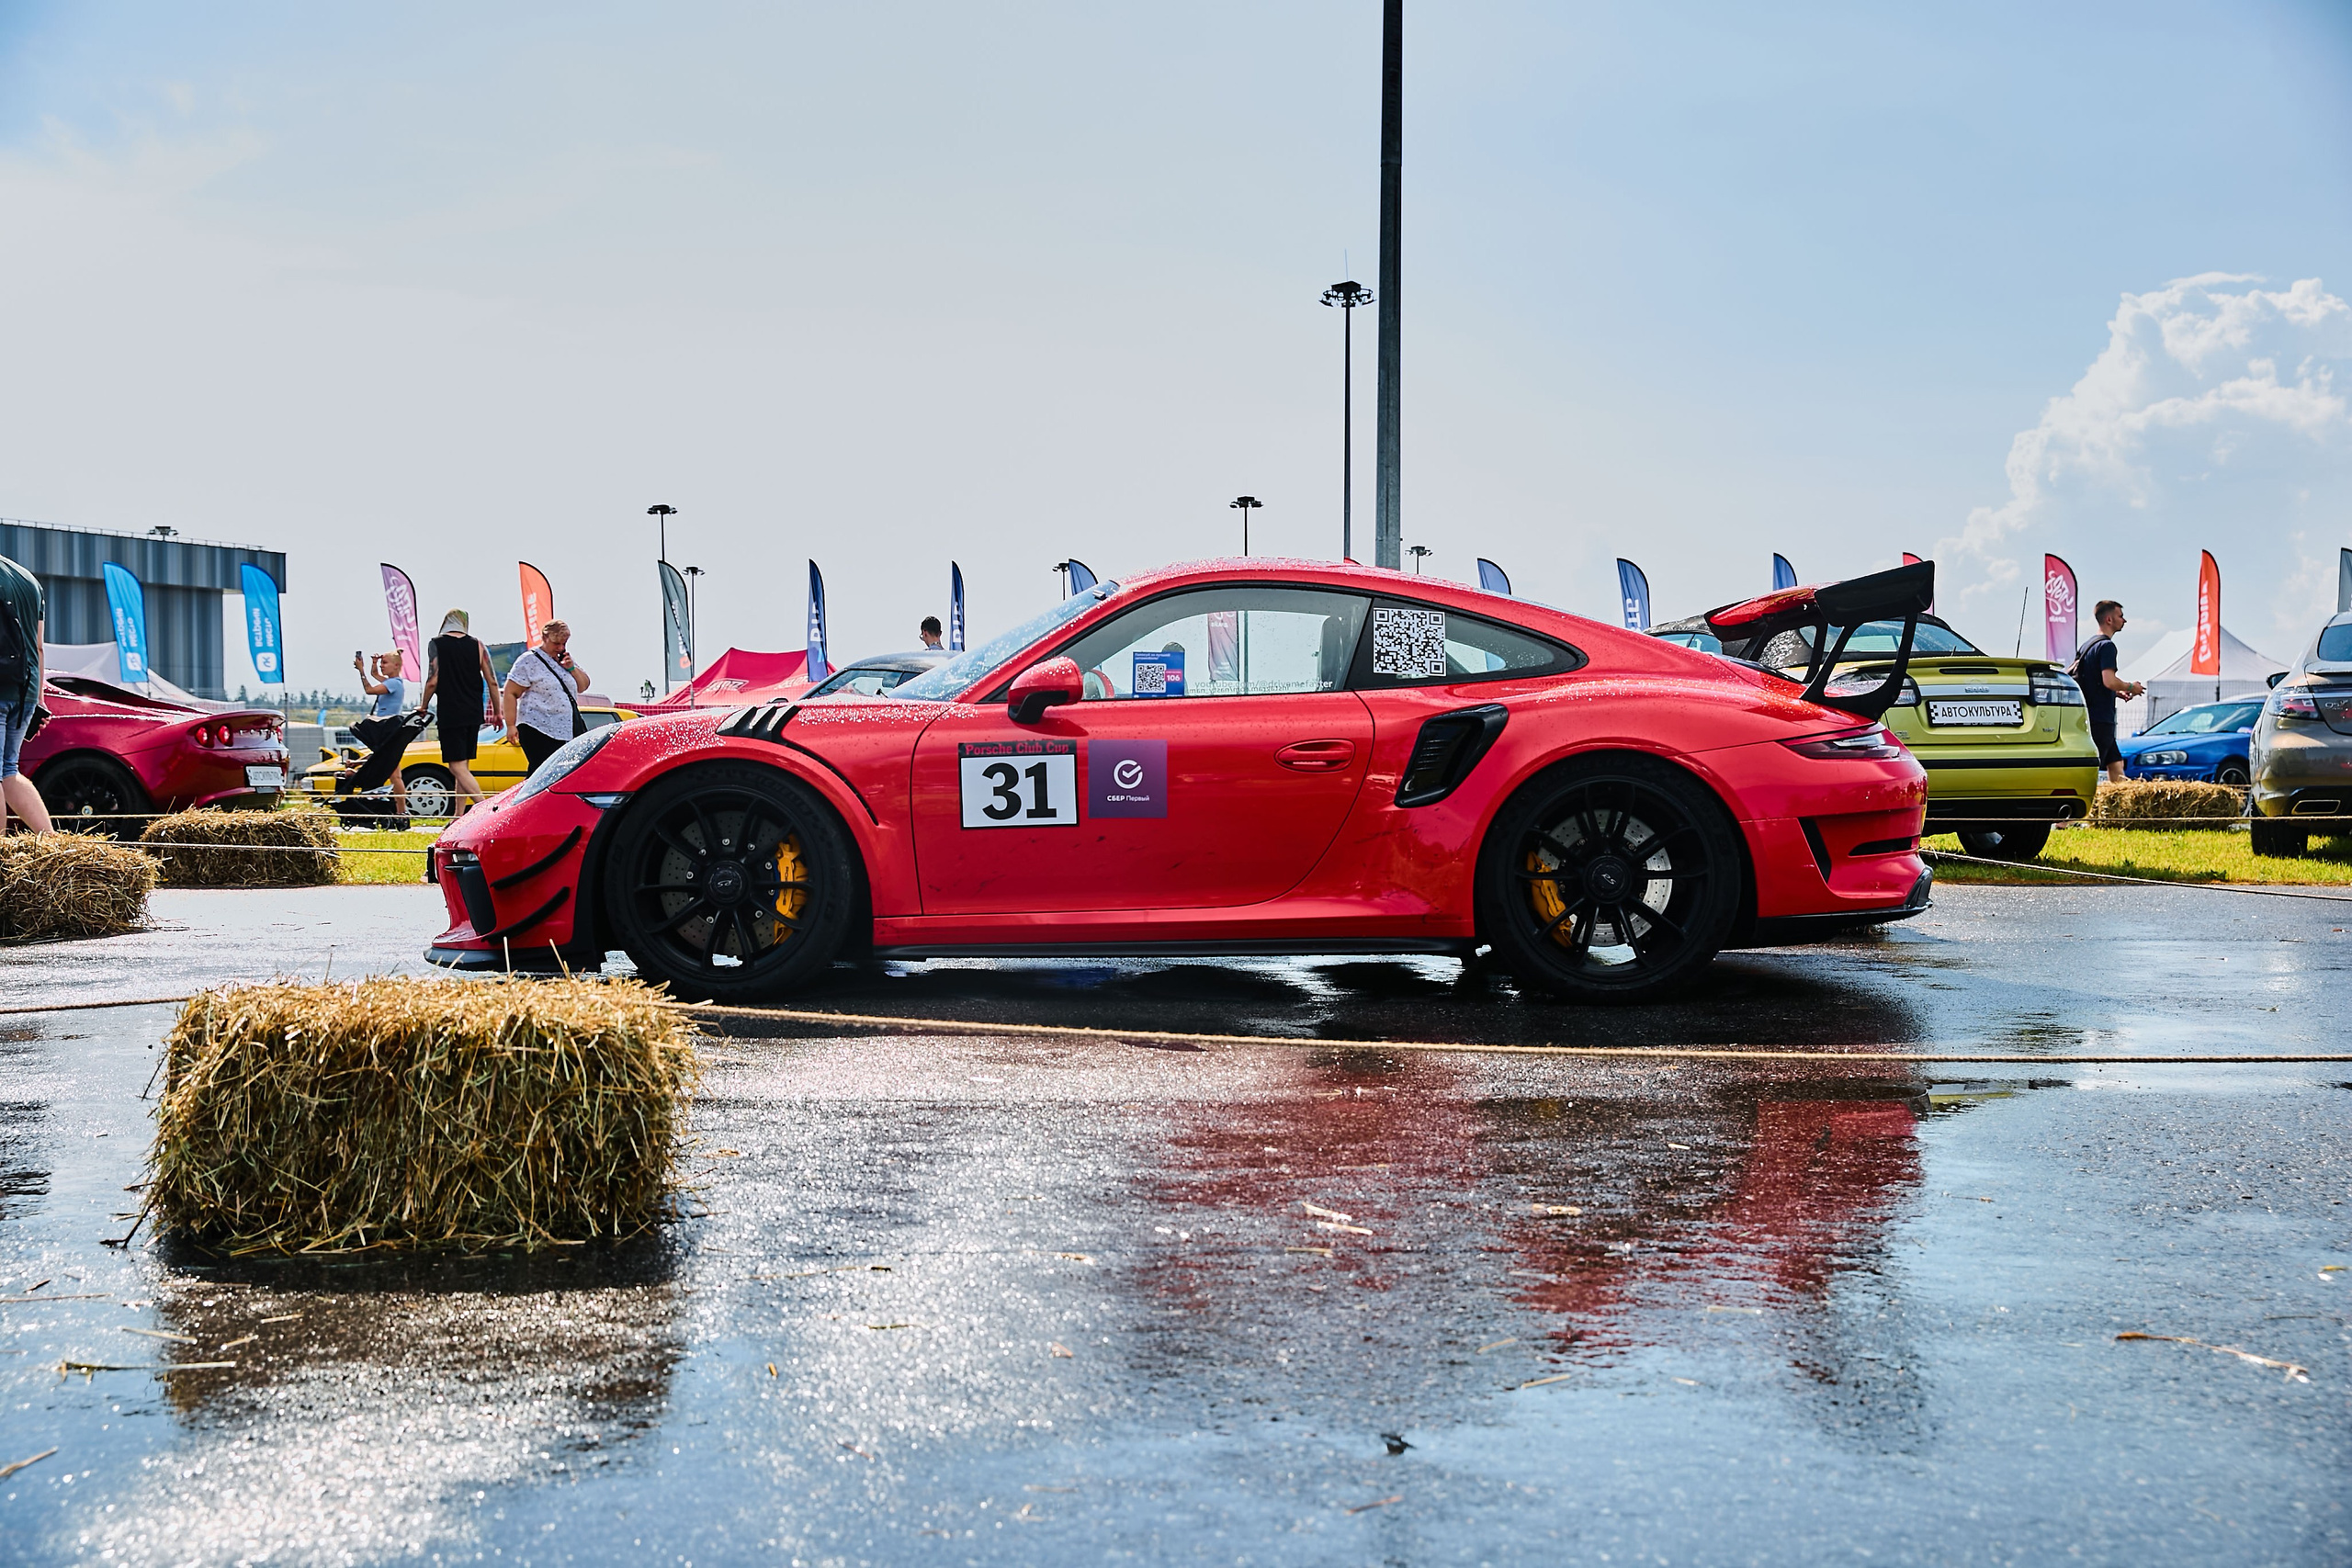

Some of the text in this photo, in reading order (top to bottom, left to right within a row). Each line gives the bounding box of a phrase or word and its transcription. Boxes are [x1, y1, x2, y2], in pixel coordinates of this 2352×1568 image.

[1941, 705, 2012, 718] АВТОКУЛЬТУРА
[966, 742, 1069, 755] Porsche Club Cup
[981, 761, 1057, 820] 31
[1125, 795, 1150, 803] Первый
